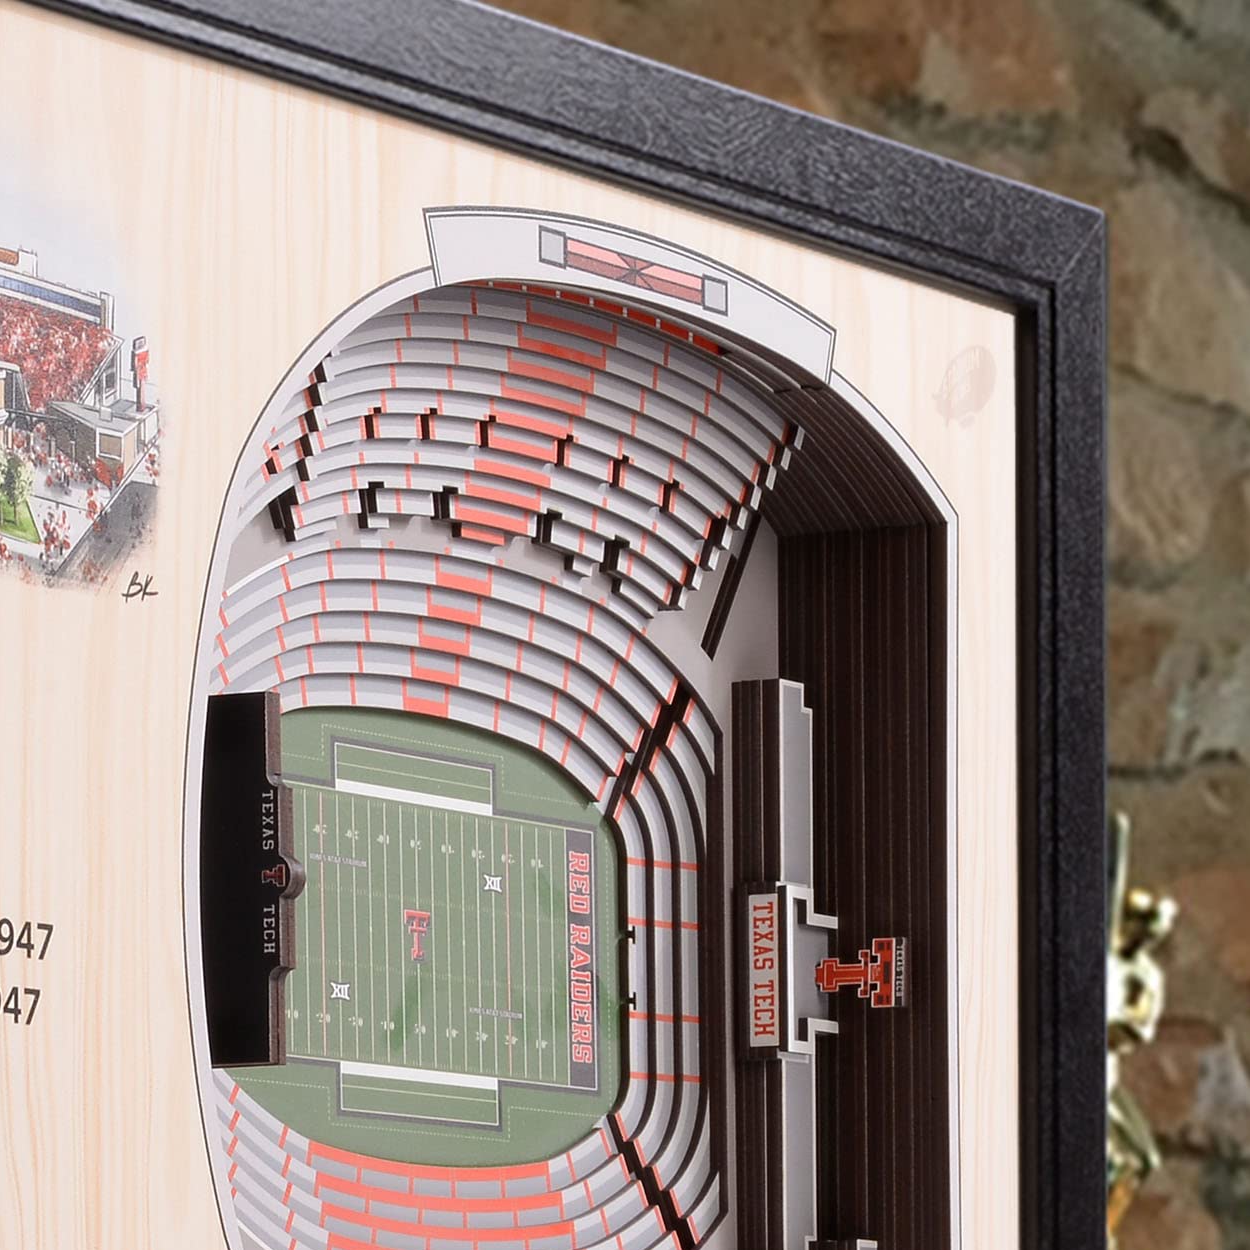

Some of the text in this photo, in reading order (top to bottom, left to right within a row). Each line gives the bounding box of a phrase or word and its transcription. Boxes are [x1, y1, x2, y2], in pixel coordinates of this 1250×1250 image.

[261, 789, 276, 953] TEXAS TECH
[568, 851, 593, 1063] RED RAIDERS
[753, 902, 775, 1037] TEXAS TECH
